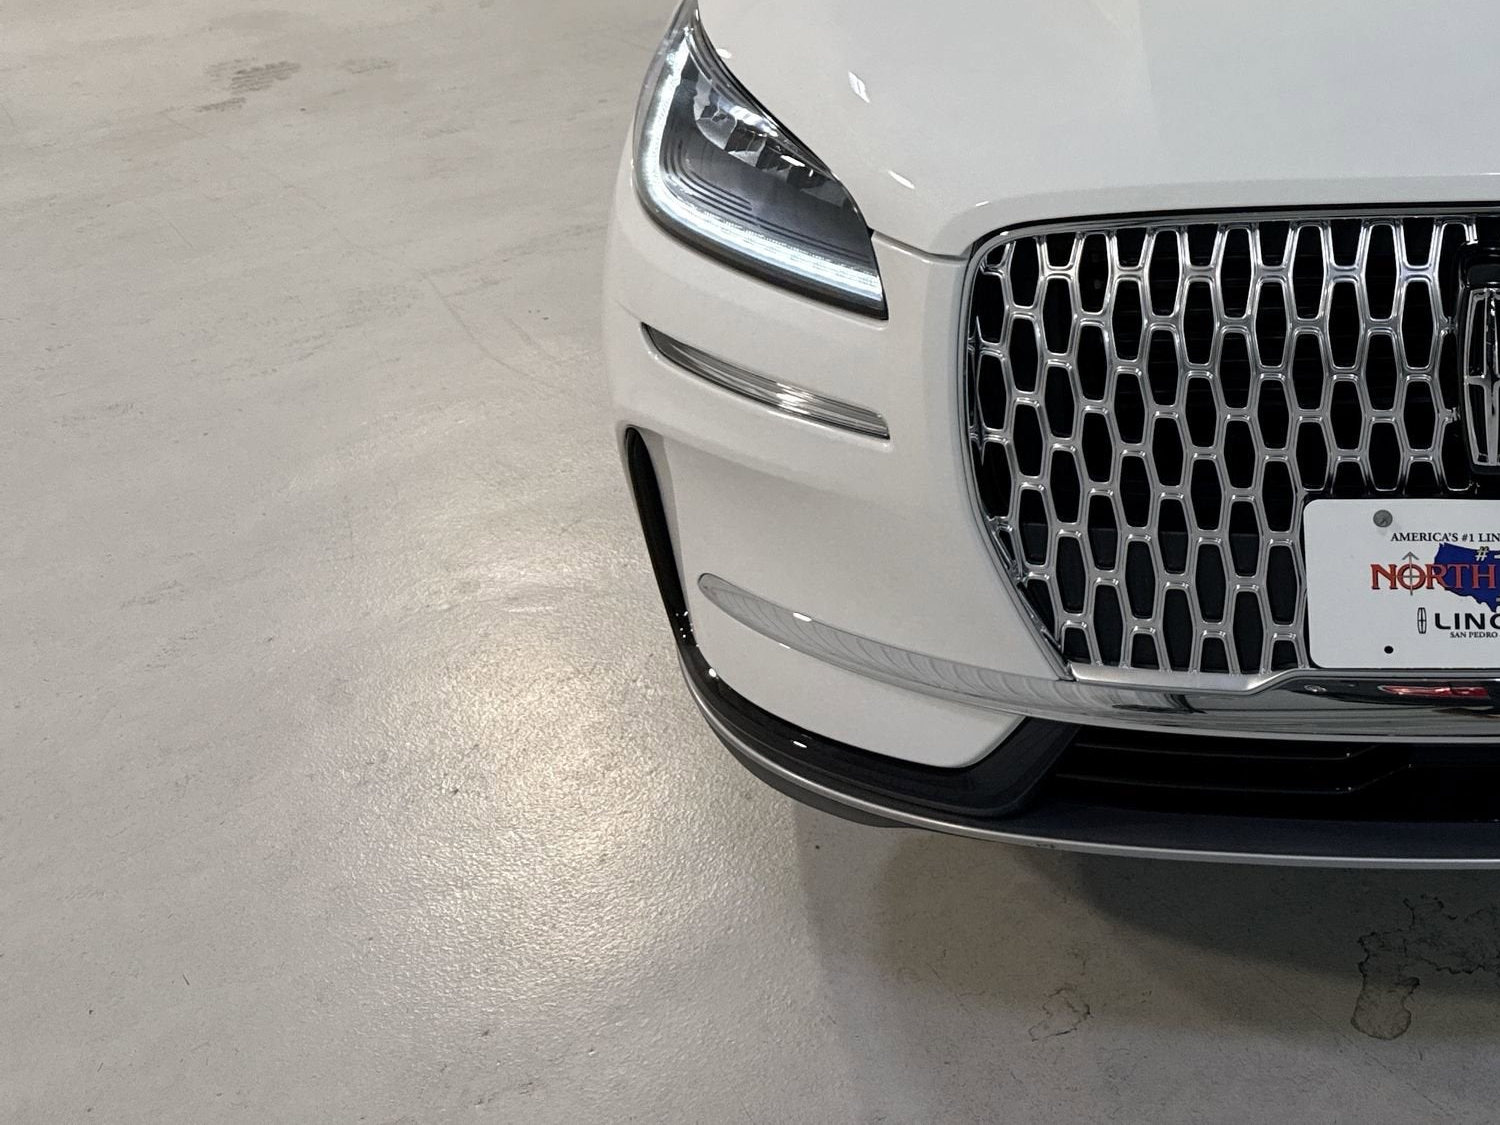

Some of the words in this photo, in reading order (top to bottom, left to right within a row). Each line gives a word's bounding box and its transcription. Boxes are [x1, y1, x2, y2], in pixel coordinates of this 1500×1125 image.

[1391, 532, 1459, 542] AMERICA'S
[1462, 533, 1475, 542] #1
[1370, 563, 1497, 591] NORTH
[1450, 631, 1467, 639] SAN
[1468, 631, 1498, 639] PEDRO
